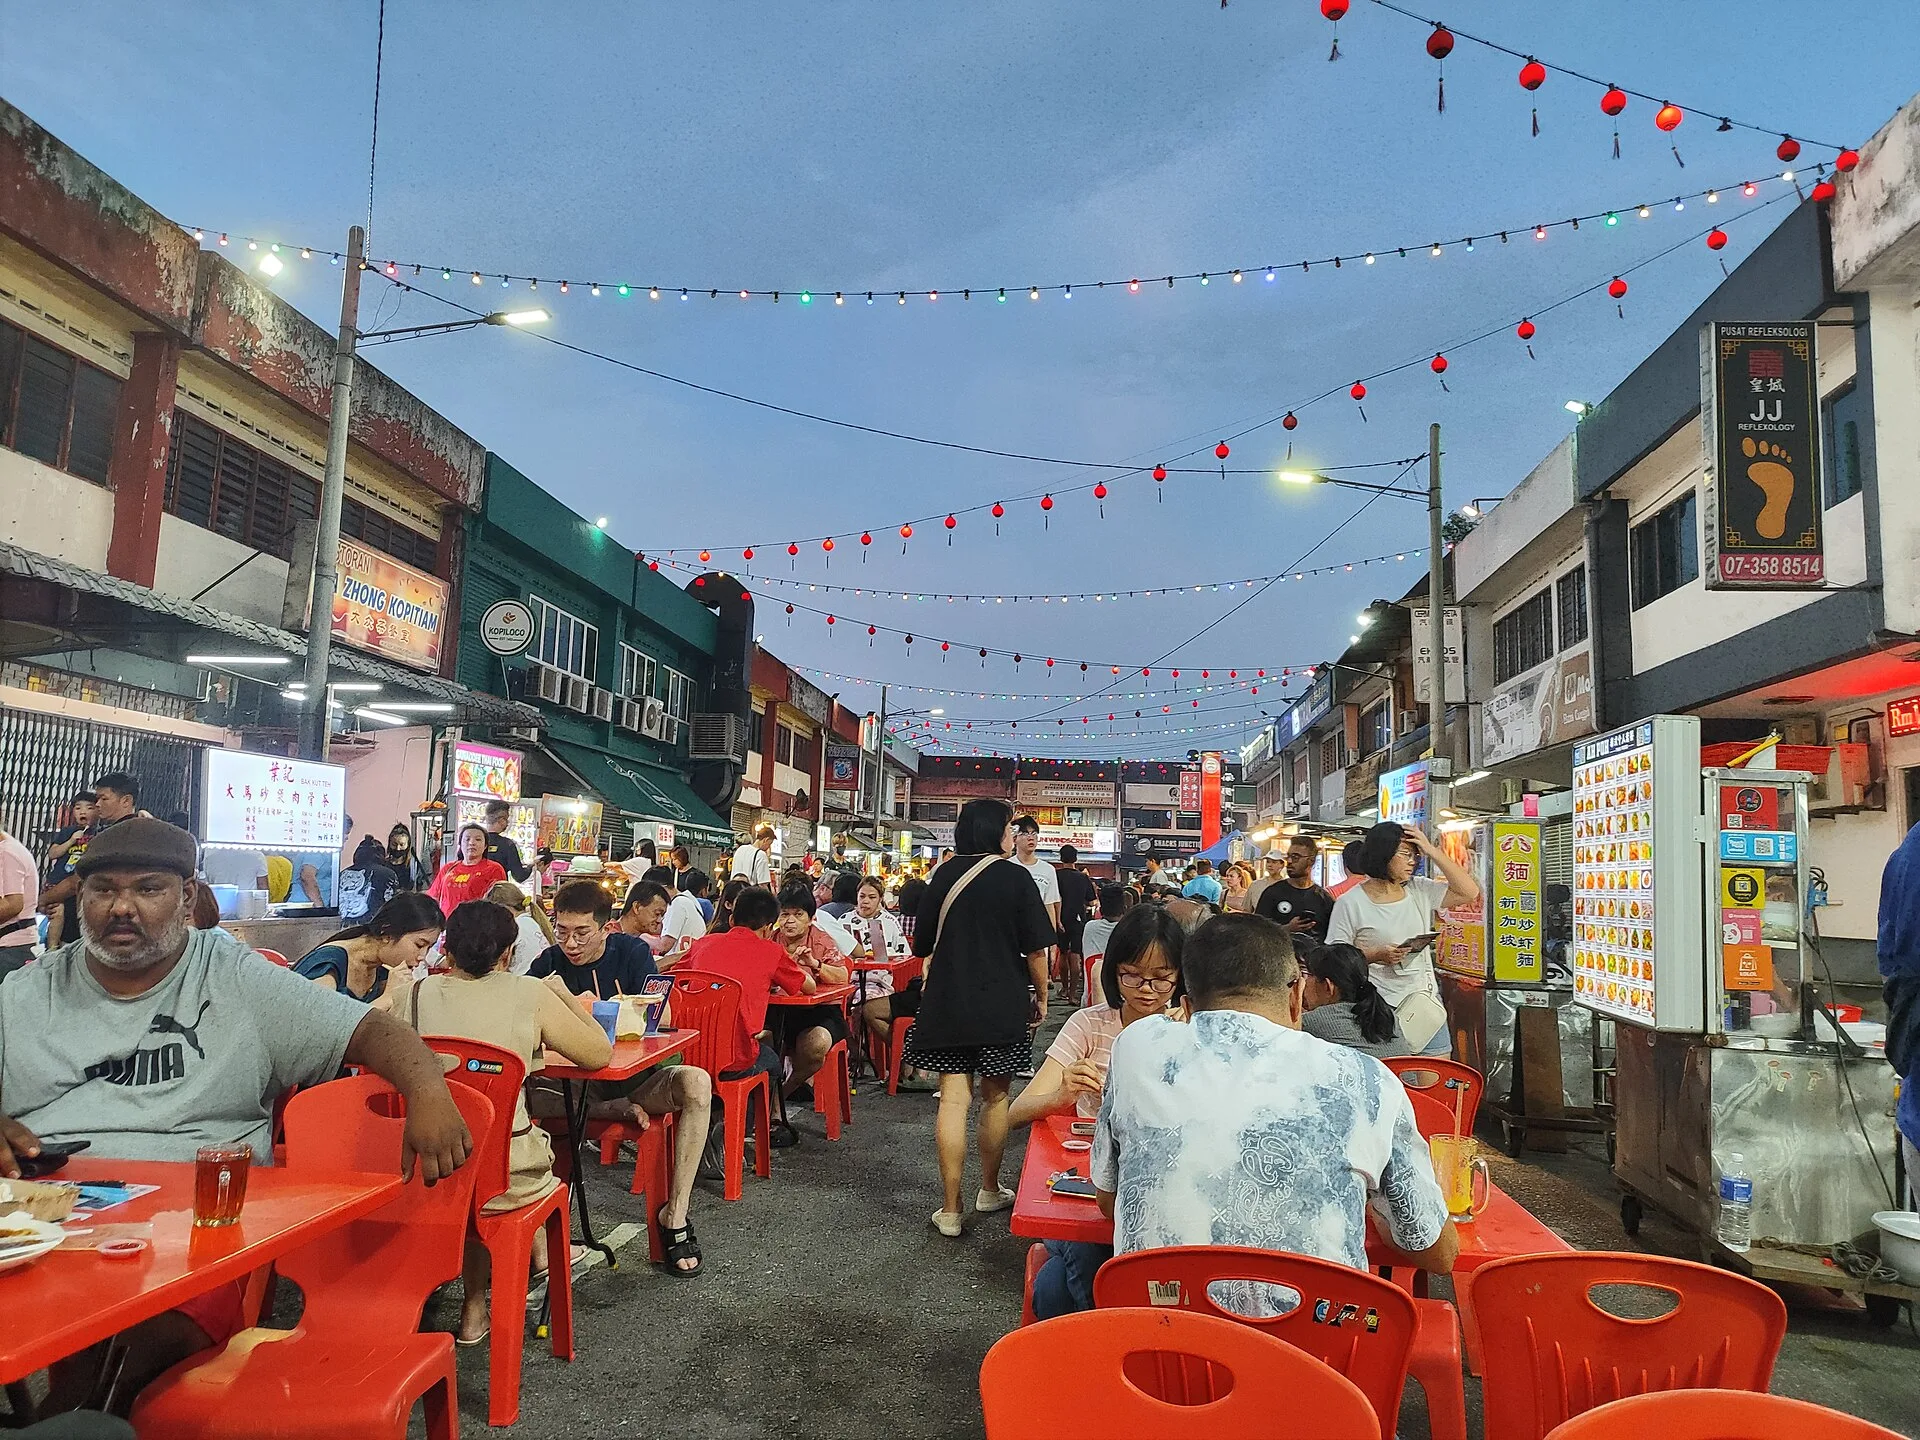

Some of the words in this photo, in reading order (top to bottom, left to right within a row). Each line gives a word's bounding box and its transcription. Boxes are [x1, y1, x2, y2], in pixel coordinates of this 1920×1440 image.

[1721, 326, 1746, 337] PUSAT
[1748, 327, 1808, 337] REFLEKSOLOGI
[1749, 377, 1785, 393] 皇城
[1750, 399, 1782, 421] JJ
[1738, 423, 1795, 431] REFLEXOLOGY
[1724, 556, 1779, 576] 07-358
[1781, 556, 1820, 575] 8514
[343, 577, 385, 611] ZHONG
[388, 595, 438, 633] KOPITIAM
[488, 627, 525, 636] KOPILOCO
[492, 757, 505, 768] FOOD
[321, 780, 331, 788] TEH
[1504, 861, 1530, 882] 麵
[1499, 897, 1517, 948] 新加坡
[1516, 918, 1536, 968] 炒虾麵
[84, 1043, 185, 1086] PUMA
